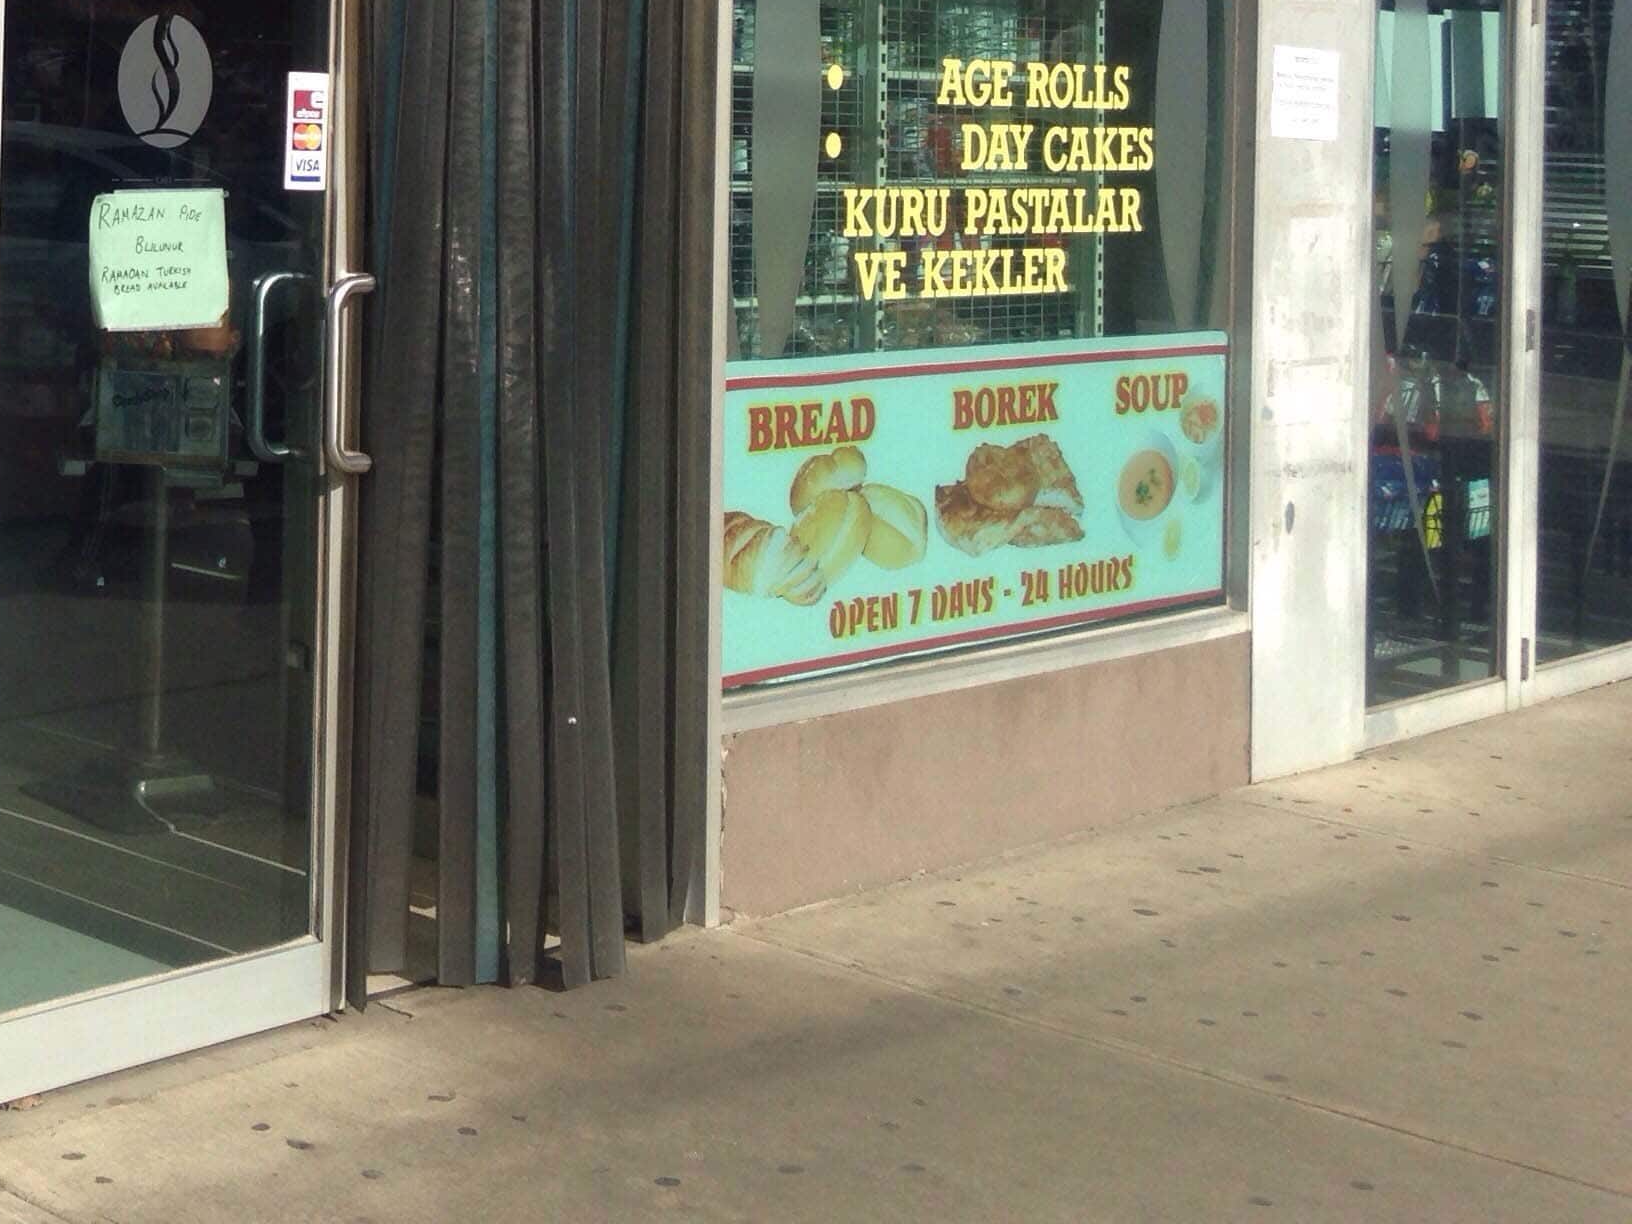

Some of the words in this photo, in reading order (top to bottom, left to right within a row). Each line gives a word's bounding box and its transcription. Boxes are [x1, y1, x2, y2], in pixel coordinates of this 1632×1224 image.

[937, 58, 1014, 107] AGE
[1026, 61, 1130, 110] ROLLS
[296, 159, 320, 171] VISA
[961, 124, 1033, 171] DAY
[1043, 126, 1155, 172] CAKES
[98, 203, 166, 230] RAMAZAN
[842, 188, 950, 237] KURU
[964, 187, 1143, 235] PASTALAR
[101, 266, 149, 282] RAMADAN
[854, 251, 907, 301] VE
[919, 248, 1068, 298] KEKLER
[952, 382, 1058, 430] BOREK
[1115, 372, 1188, 415] SOUP
[747, 397, 876, 452] BREAD
[829, 590, 899, 639] OPEN
[907, 589, 923, 625] 7
[931, 576, 994, 621] DAYS
[1020, 569, 1050, 607] 24
[1058, 554, 1134, 599] HOURS
